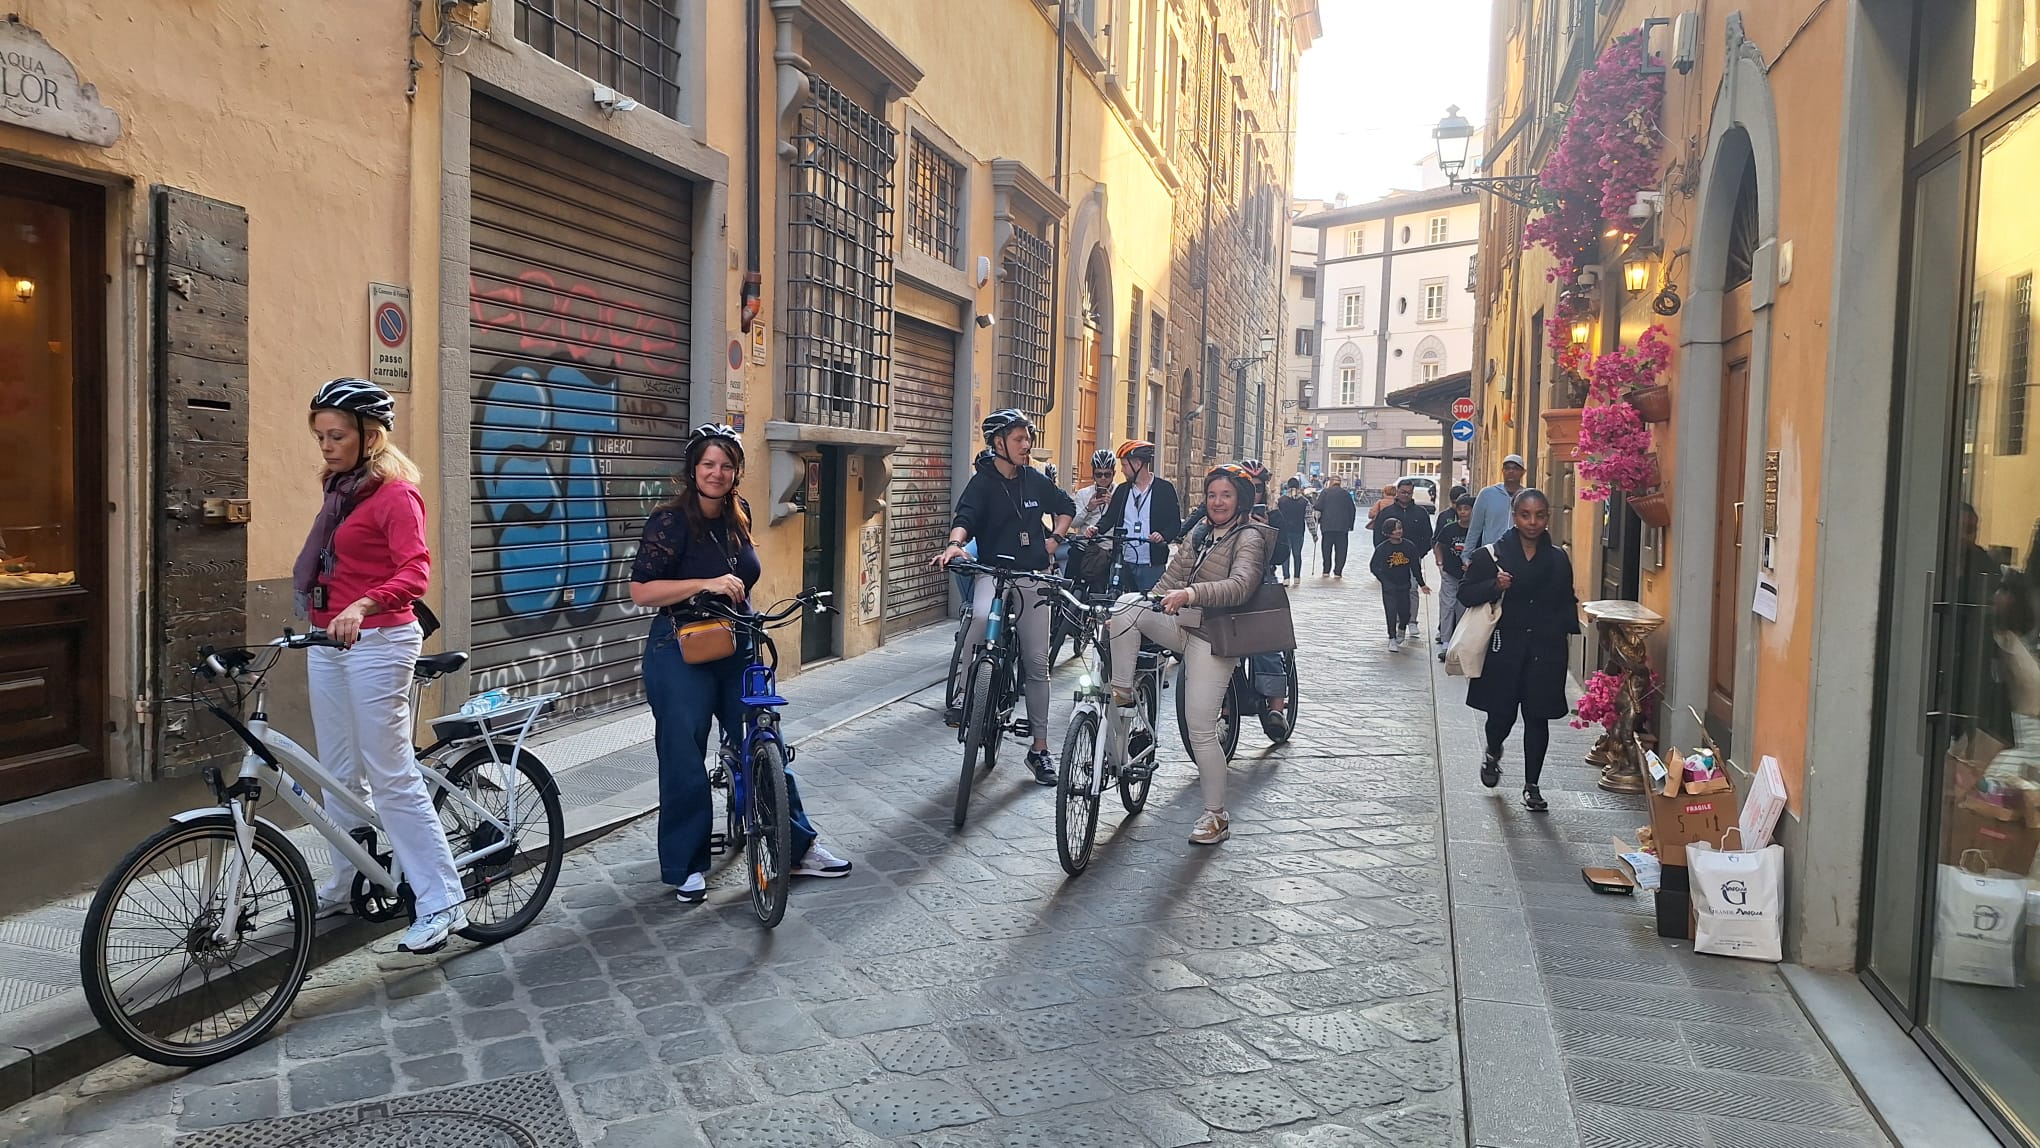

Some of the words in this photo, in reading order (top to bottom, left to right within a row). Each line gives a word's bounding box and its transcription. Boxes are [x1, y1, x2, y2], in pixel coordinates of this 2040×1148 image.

[379, 354, 403, 365] passo
[373, 366, 408, 379] carrabile
[1453, 404, 1474, 414] STOP
[598, 439, 633, 454] LIBERO
[1686, 803, 1712, 813] FRAGILE
